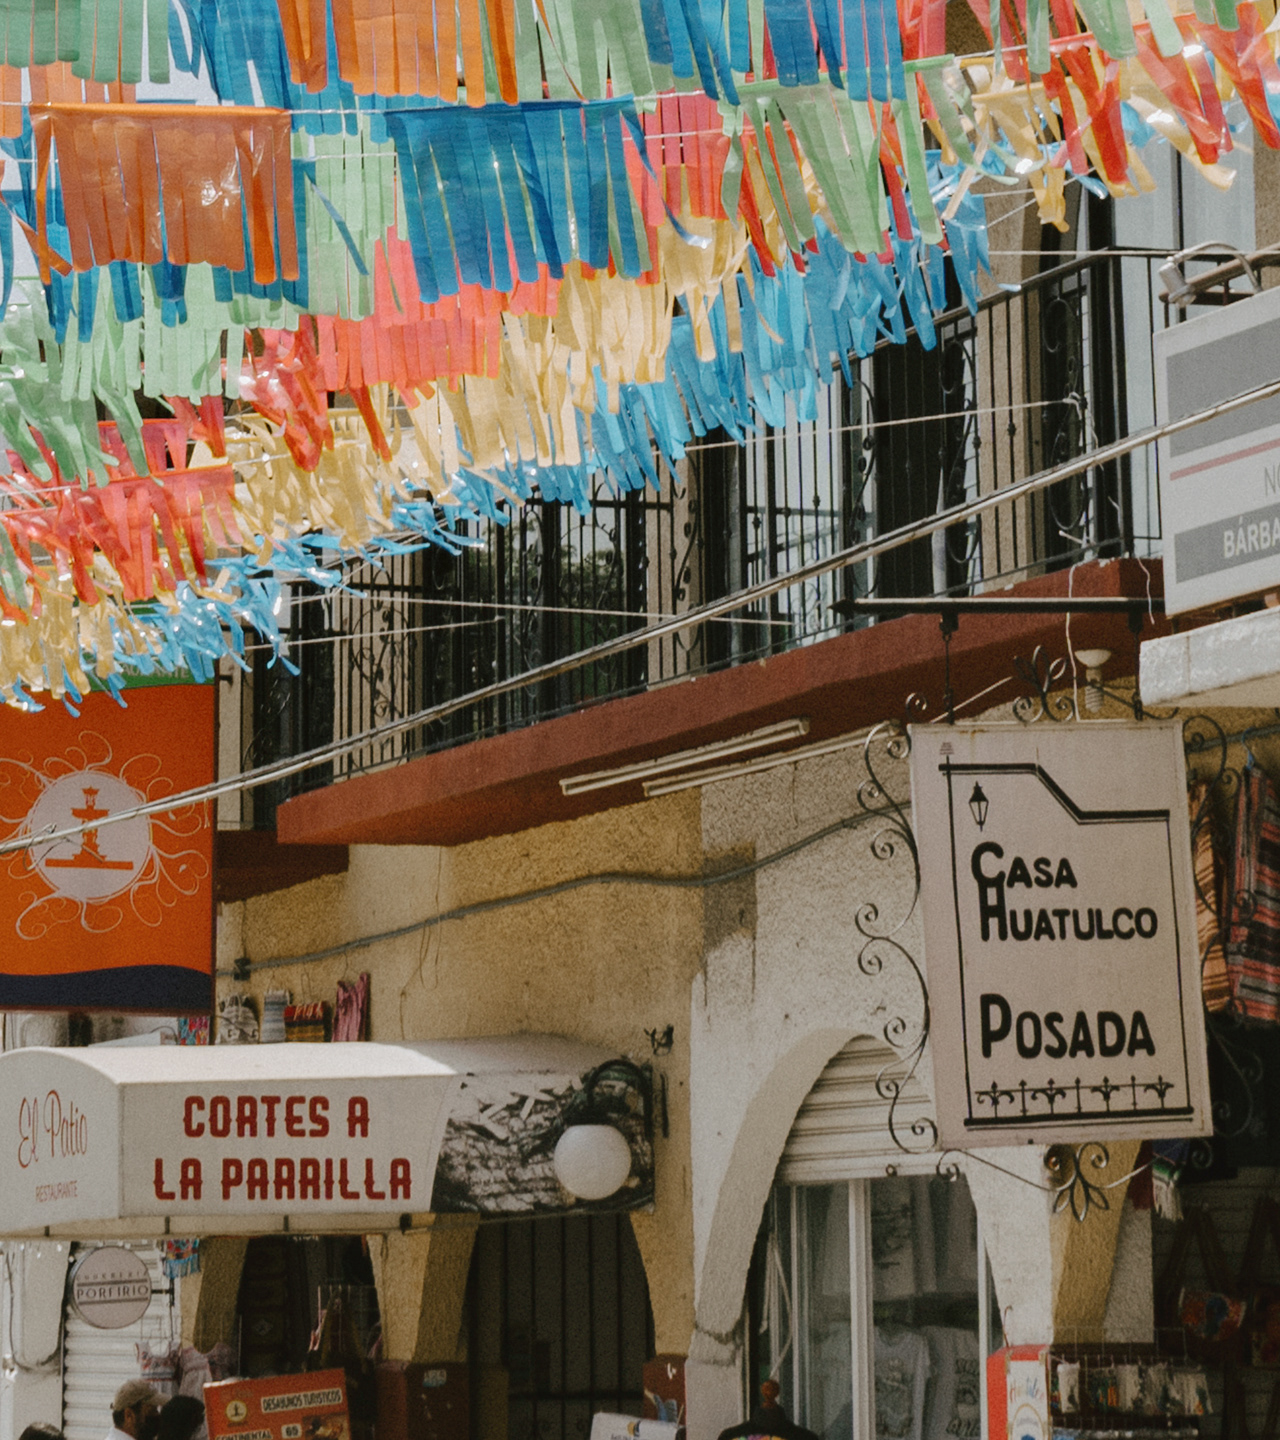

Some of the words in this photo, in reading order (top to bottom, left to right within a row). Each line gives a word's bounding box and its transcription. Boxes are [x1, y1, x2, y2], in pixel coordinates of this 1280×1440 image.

[970, 842, 1078, 888] CASA
[980, 880, 1158, 941] HUATULCO
[980, 994, 1156, 1058] POSADA
[17, 1096, 39, 1169] El
[43, 1089, 88, 1157] Patio
[183, 1095, 330, 1138] CORTES
[348, 1095, 370, 1138] A
[154, 1158, 203, 1200] LA
[221, 1158, 413, 1200] PARRILLA
[77, 1284, 149, 1300] PORFIRIO
